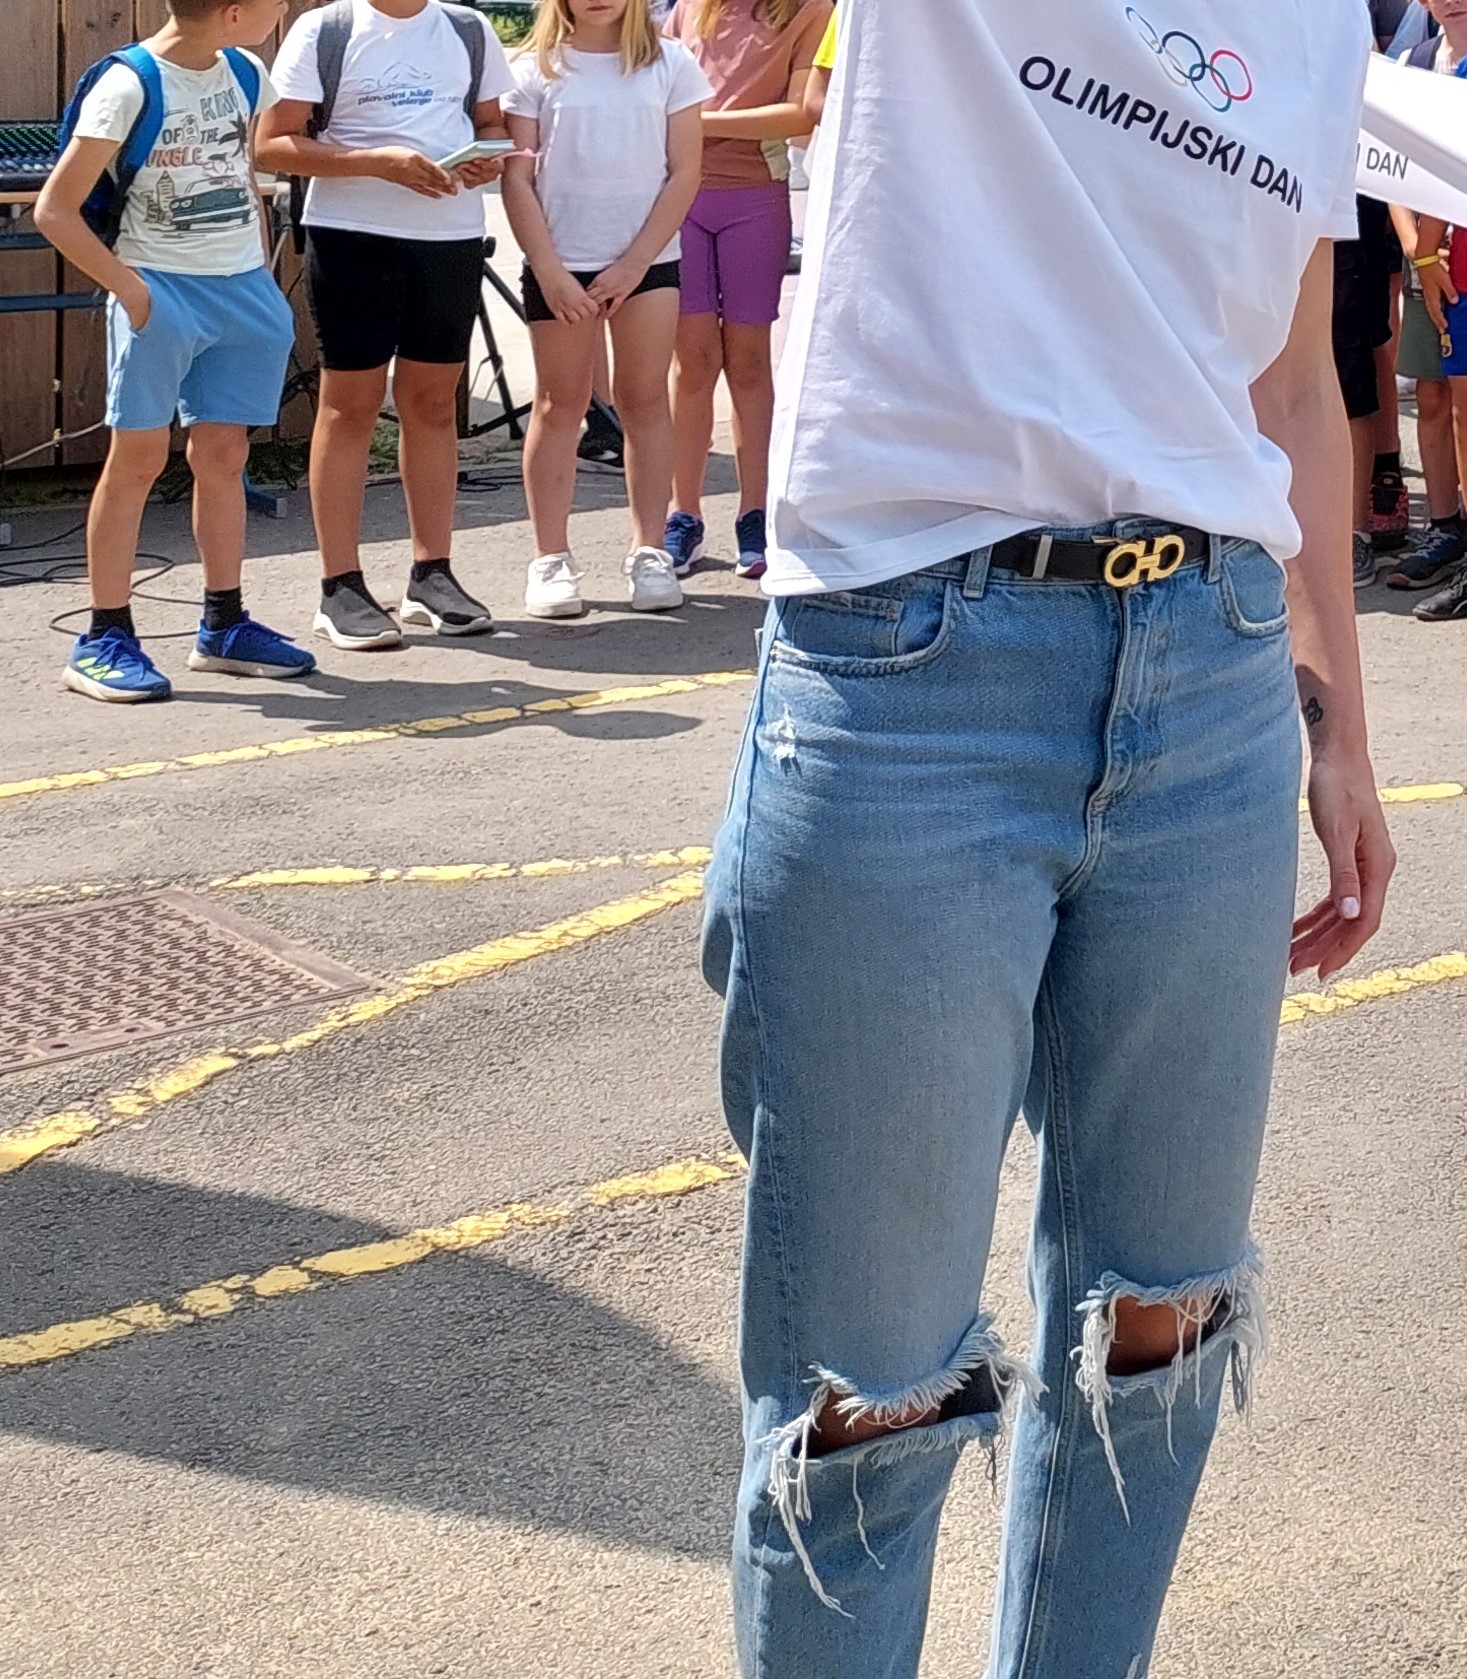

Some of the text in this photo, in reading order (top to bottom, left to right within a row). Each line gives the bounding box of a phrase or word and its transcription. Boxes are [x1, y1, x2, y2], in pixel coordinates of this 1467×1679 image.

[162, 127, 220, 145] OF THE
[1019, 56, 1303, 213] OLIMPIJSKI DAN
[1366, 147, 1409, 180] DAN
